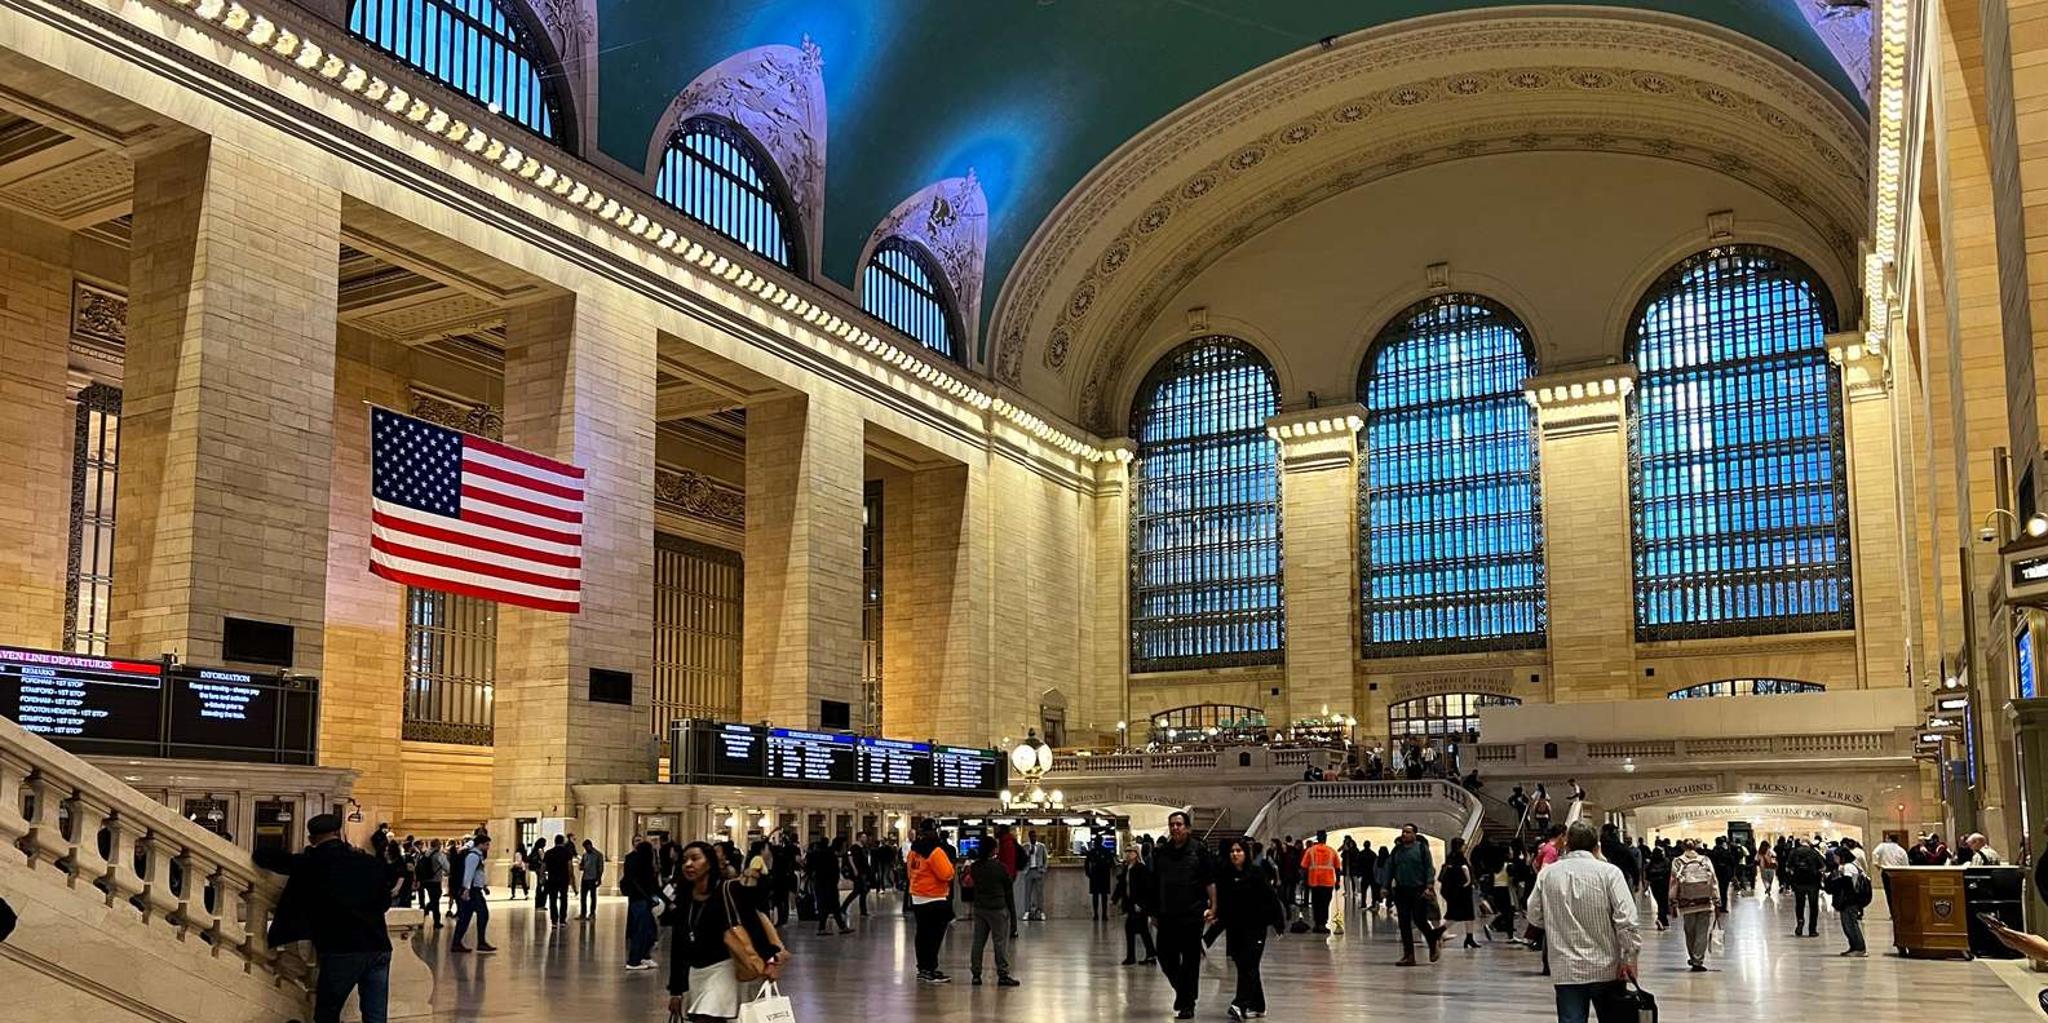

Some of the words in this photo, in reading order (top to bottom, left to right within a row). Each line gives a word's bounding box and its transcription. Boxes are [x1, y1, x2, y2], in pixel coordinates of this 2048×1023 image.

[0, 650, 25, 660] VEN
[26, 652, 49, 664] LINE
[51, 656, 112, 669] DEPARTURES
[21, 677, 52, 685] FORDHAM
[200, 671, 251, 682] INFORMATION
[1415, 676, 1467, 687] VANDERBILT
[20, 686, 54, 695] STAMFORD
[19, 696, 52, 704] FORDHAM
[80, 709, 92, 717] 1ST
[92, 710, 109, 718] STOP
[19, 715, 53, 723] STAMFORD
[1628, 789, 1660, 801] TICKET
[1664, 783, 1715, 795] MACHINES
[1748, 783, 1787, 793] TRACKS
[1828, 790, 1851, 800] LIRR
